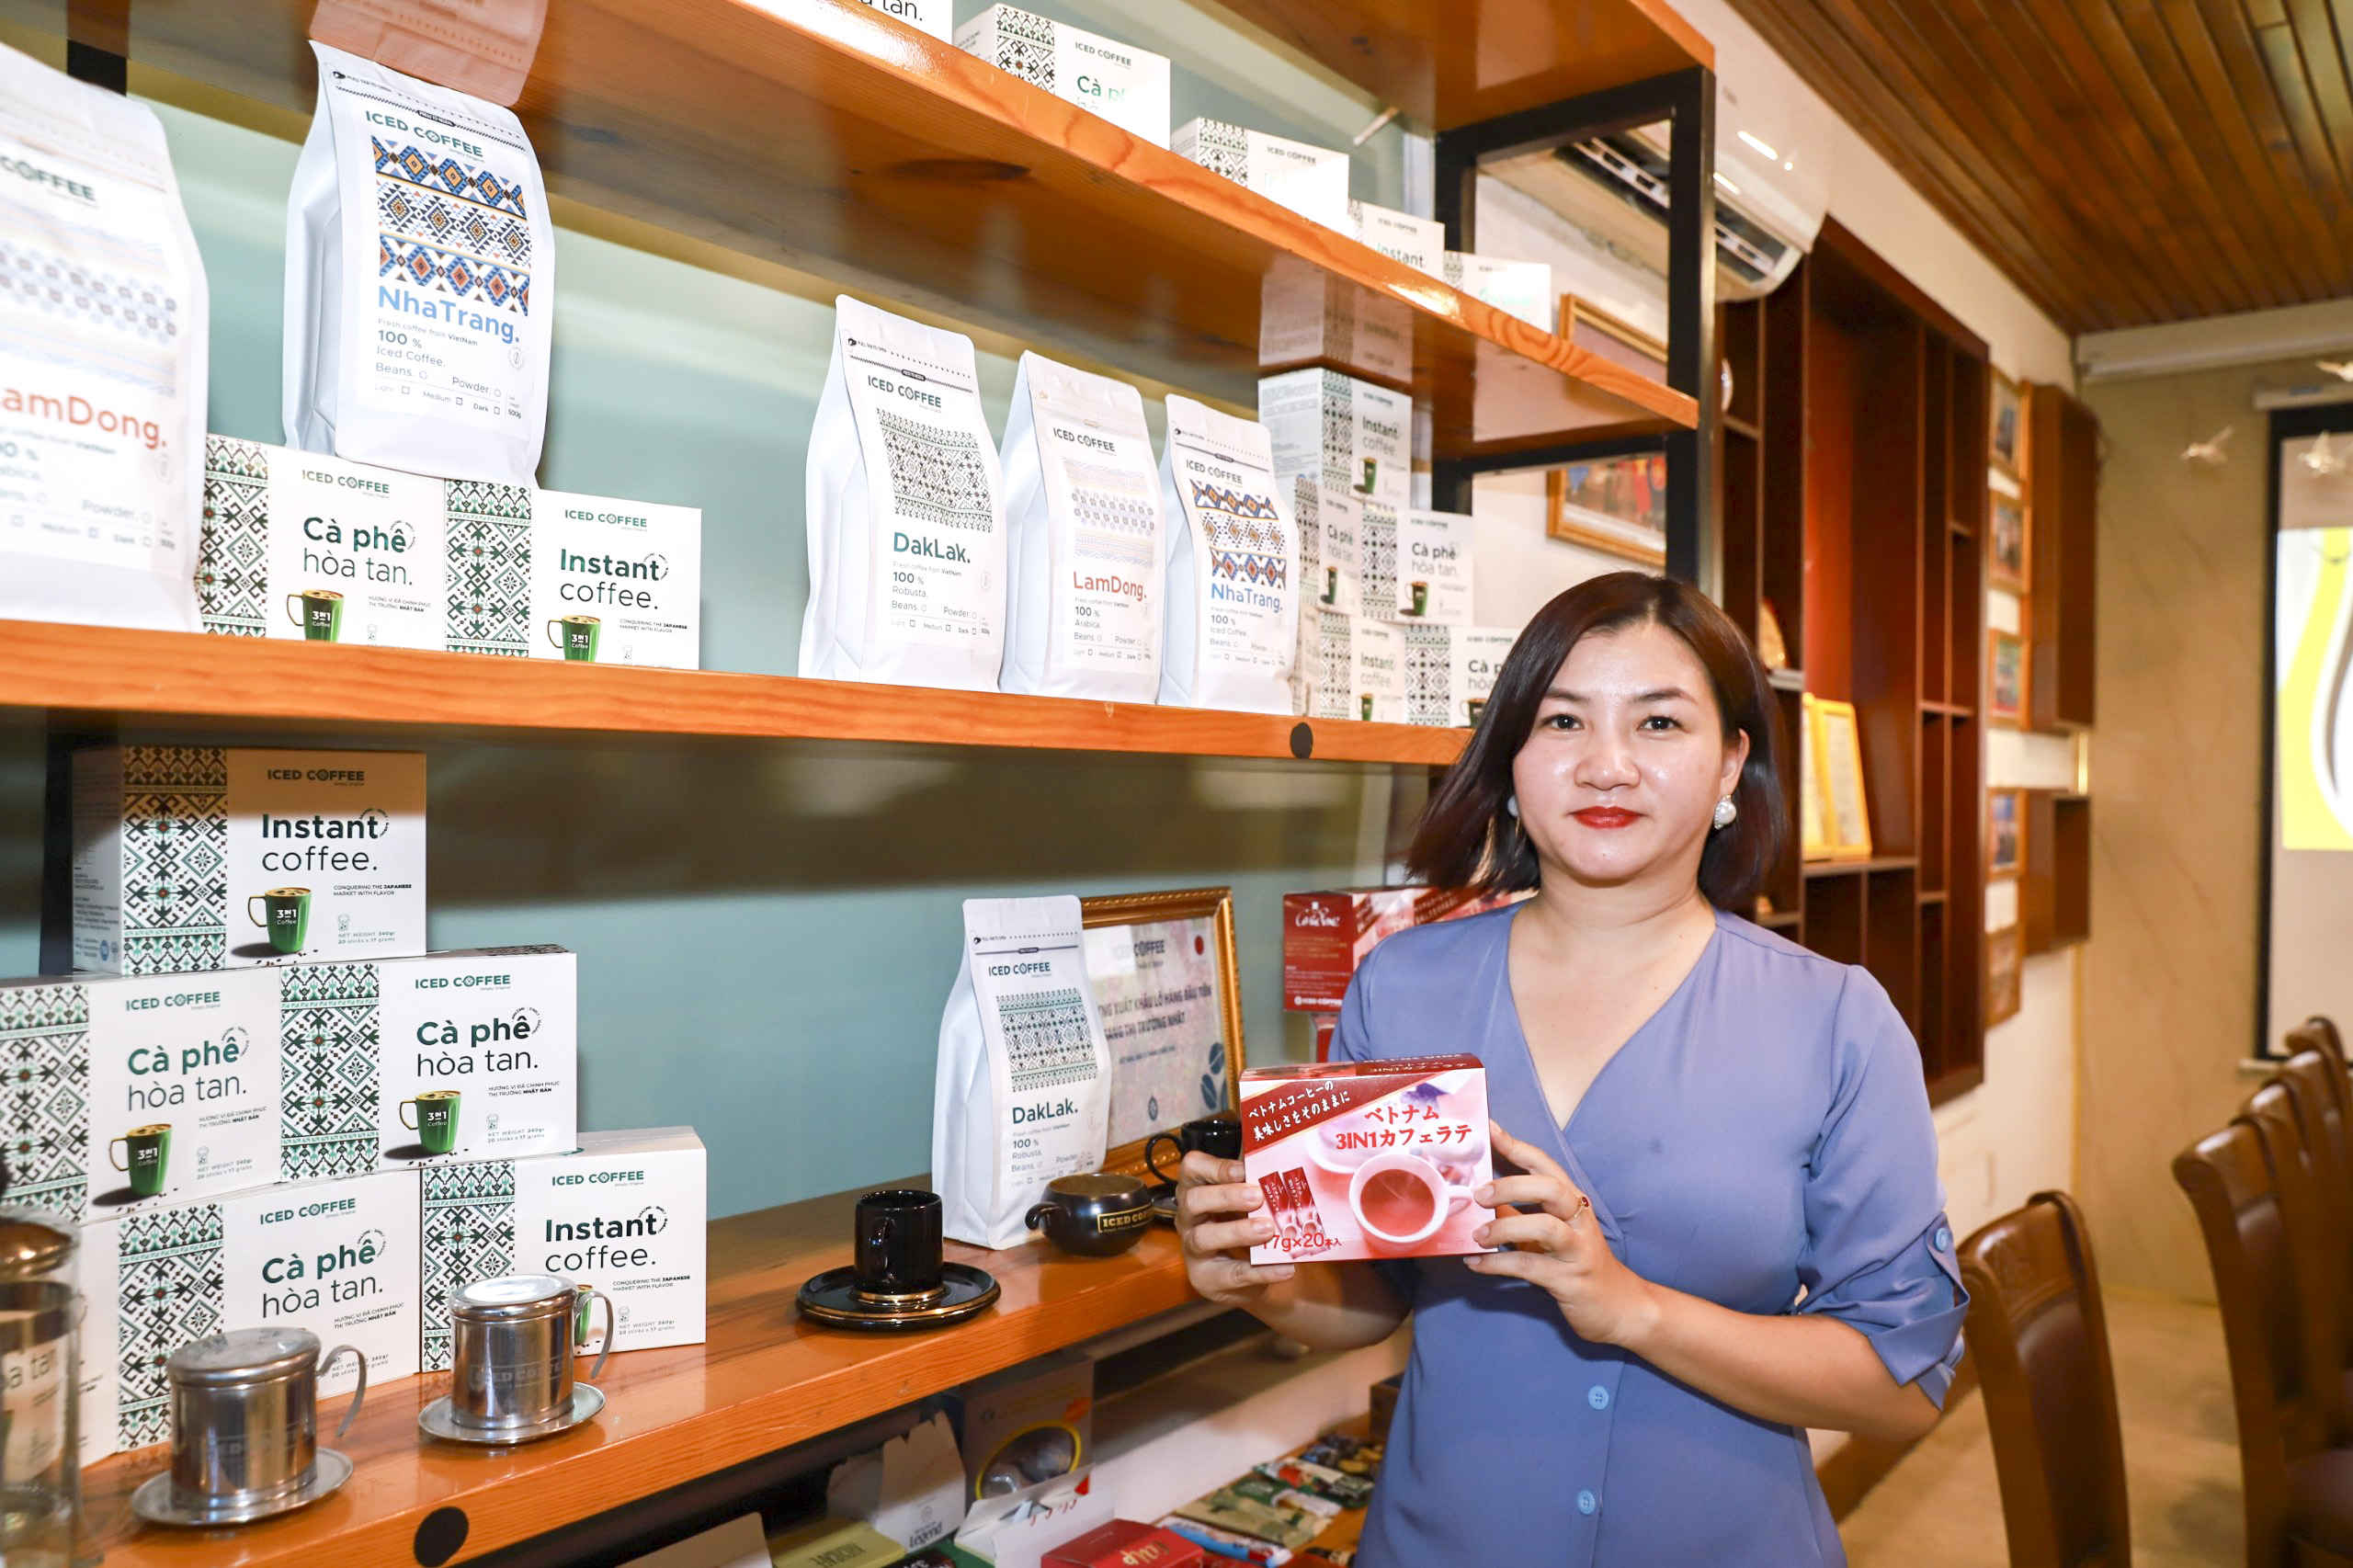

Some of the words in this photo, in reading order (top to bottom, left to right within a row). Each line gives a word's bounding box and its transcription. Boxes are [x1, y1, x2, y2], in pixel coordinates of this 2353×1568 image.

[1075, 41, 1096, 54] ICED
[1097, 50, 1131, 66] COFFEE
[1077, 75, 1101, 97] Cà
[366, 110, 408, 131] ICED
[414, 126, 483, 158] COFFEE
[1267, 146, 1285, 158] ICED
[1287, 150, 1315, 165] COFFEE
[1, 156, 97, 201] COFFEE
[379, 285, 519, 344] NhaTrang.
[378, 319, 401, 329] Fresh
[403, 323, 426, 335] coffee
[429, 328, 446, 338] from
[448, 334, 478, 347] VietNam
[378, 330, 407, 345] 100
[413, 338, 422, 348] %
[377, 346, 402, 358] Iced
[406, 350, 446, 367] Coffee.
[376, 362, 415, 377] Beans.
[452, 377, 491, 395] Powder.
[423, 392, 451, 403] Medium
[473, 403, 489, 413] Dark
[868, 375, 894, 392] ICED
[898, 385, 941, 408] COFFEE
[1053, 427, 1074, 442] ICED
[1077, 435, 1116, 452] COFFEE
[302, 470, 333, 483] ICED
[337, 476, 390, 494] COFFEE
[1186, 459, 1205, 473] ICED
[1208, 466, 1243, 484] COFFEE
[565, 509, 594, 521] ICED
[598, 513, 647, 528] COFFEE
[303, 517, 342, 544] Cà
[354, 525, 406, 553] phê
[893, 532, 971, 563] DakLak.
[1412, 542, 1428, 557] Cà
[303, 548, 356, 578] hòa
[366, 557, 413, 585] tan.
[561, 549, 659, 581] Instant
[892, 572, 915, 583] 100
[560, 581, 658, 609] coffee.
[1074, 571, 1147, 602] LamDong.
[1211, 583, 1283, 614] NhaTrang.
[892, 600, 919, 611] Beans.
[1075, 606, 1091, 617] 100
[1211, 615, 1228, 624] 100
[1469, 660, 1490, 673] Cà
[267, 769, 302, 780] ICED
[307, 769, 364, 781] COFFEE
[262, 813, 379, 839] Instant
[262, 846, 377, 871] coffee.
[1133, 939, 1165, 957] COFFEE
[988, 965, 1010, 976] ICED
[1013, 961, 1051, 975] COFFEE
[415, 979, 449, 989] ICED
[453, 974, 510, 988] COFFEE
[126, 997, 160, 1011] ICED
[165, 992, 221, 1007] COFFEE
[416, 1019, 458, 1046] Cà
[472, 1015, 530, 1048] phê
[128, 1045, 169, 1075] Cà
[182, 1036, 239, 1074] phê
[417, 1051, 473, 1077] hòa
[484, 1050, 538, 1072] tan.
[129, 1081, 184, 1111] hòa
[195, 1075, 246, 1101] tan.
[1248, 1080, 1334, 1119] ベトナムコーヒーの
[1012, 1097, 1078, 1124] DakLak.
[1253, 1090, 1350, 1142] 美味しさをそのままに
[1364, 1104, 1439, 1123] ベトナム
[1013, 1139, 1030, 1149] 100
[1336, 1123, 1472, 1150] 3IN1カフェラテ
[138, 1158, 158, 1167] Coffee
[552, 1176, 584, 1186] ICED
[588, 1170, 644, 1184] COFFEE
[260, 1210, 294, 1224] ICED
[299, 1198, 356, 1217] COFFEE
[1103, 1215, 1131, 1227] ICED
[546, 1213, 657, 1242] Instant
[262, 1253, 304, 1284] Cà
[317, 1238, 376, 1279] phê
[545, 1245, 655, 1273] coffee.
[263, 1288, 320, 1318] hòa
[331, 1276, 383, 1303] tan.
